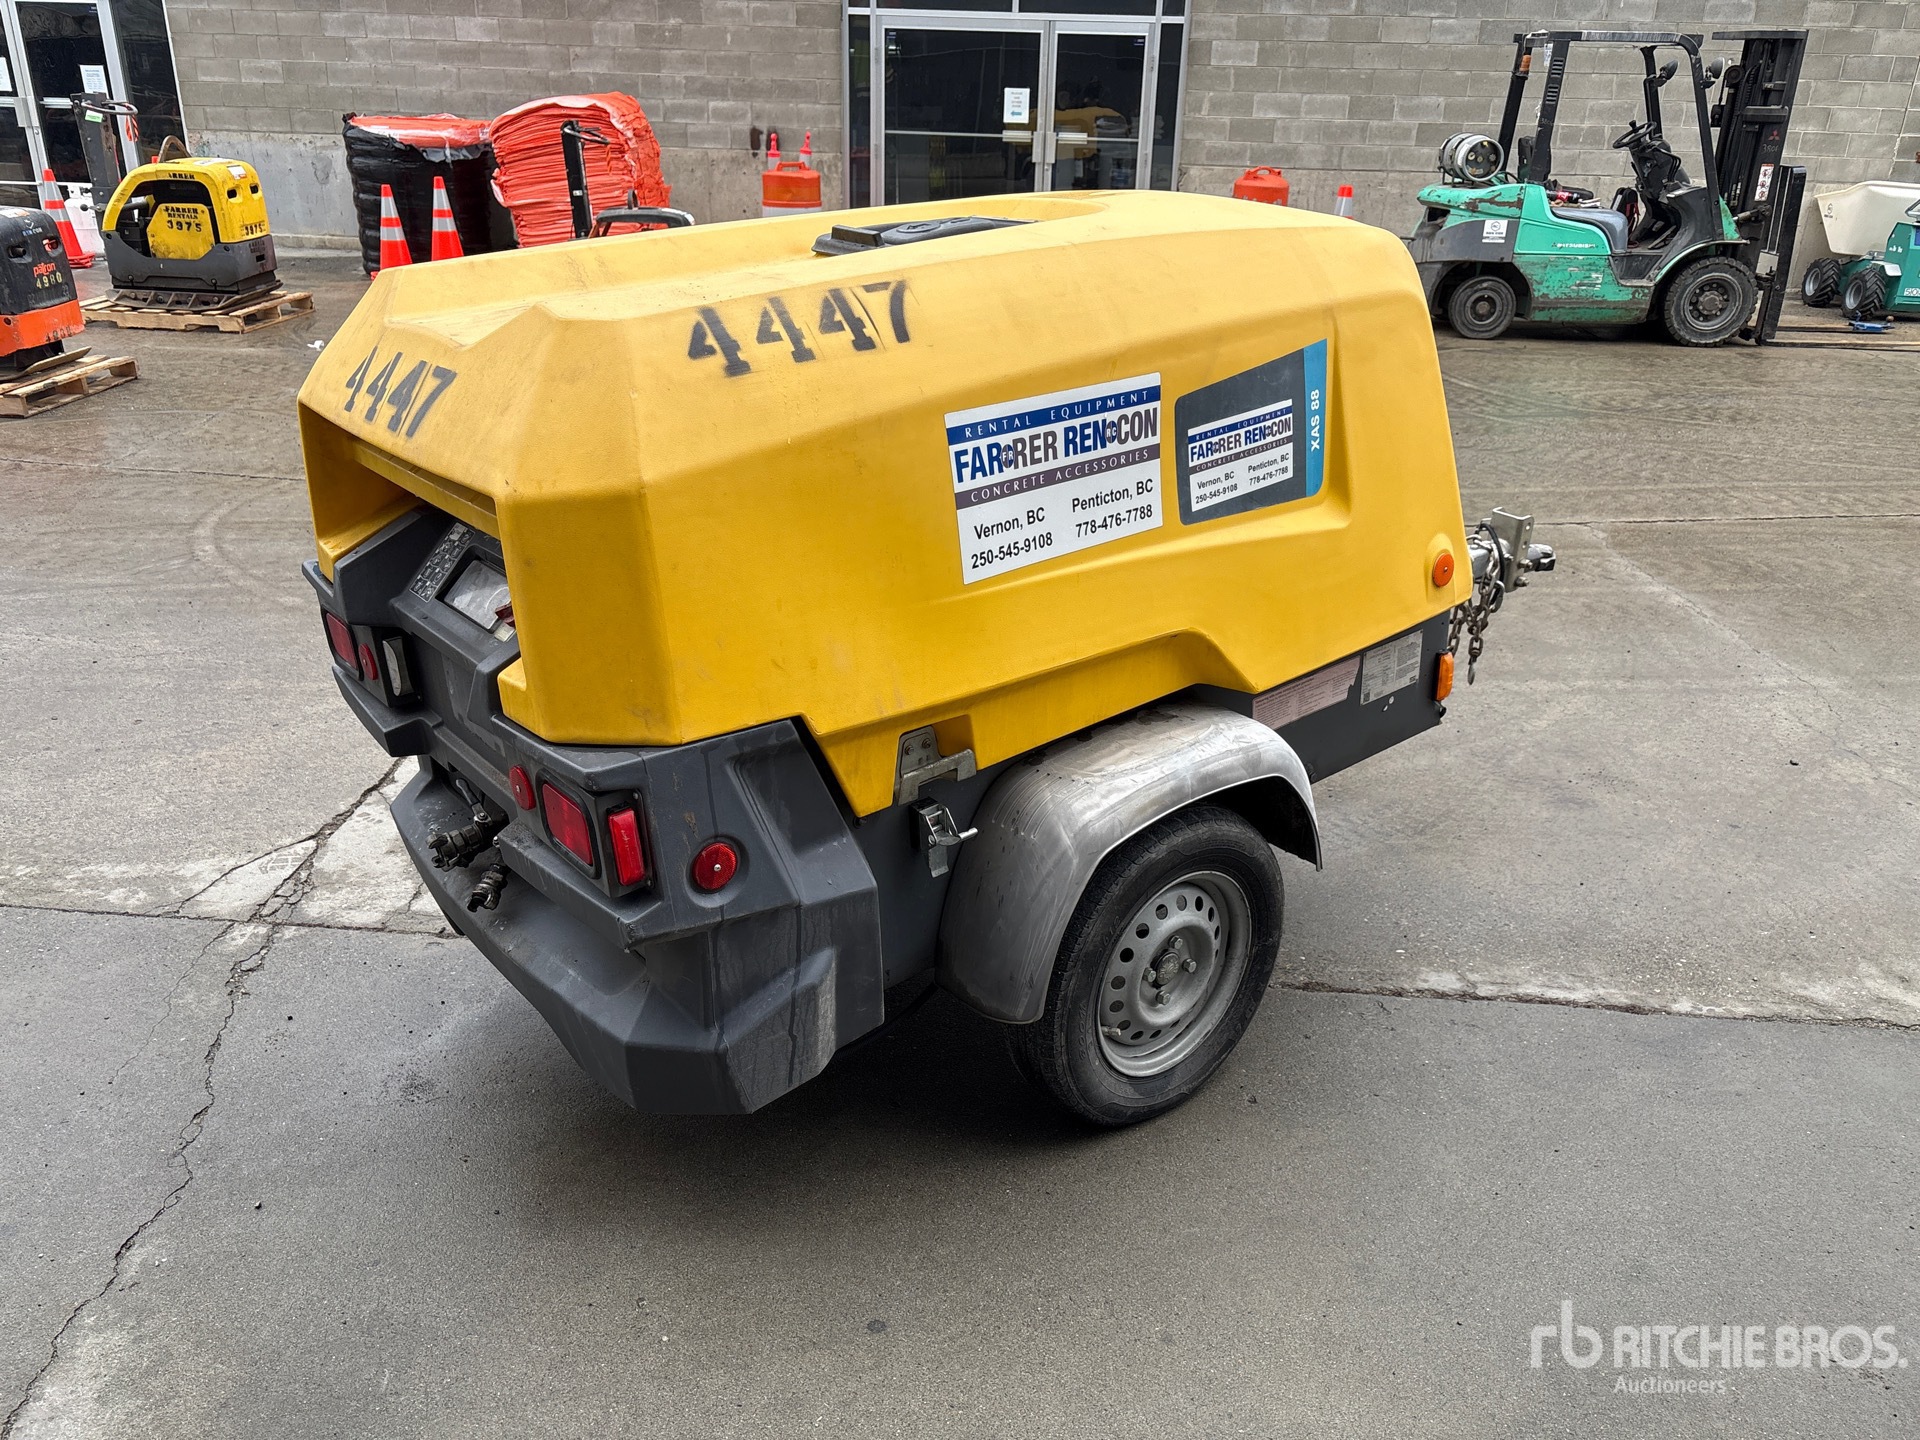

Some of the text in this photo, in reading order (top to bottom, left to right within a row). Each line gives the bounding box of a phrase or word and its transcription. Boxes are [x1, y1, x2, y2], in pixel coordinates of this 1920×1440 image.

[166, 220, 202, 233] 3975
[244, 223, 263, 236] 3975
[35, 271, 63, 289] 4980
[687, 279, 910, 377] 4447
[343, 345, 457, 439] 4447
[965, 390, 1149, 438] RENTAL EQUIPMENT
[1195, 409, 1287, 441] RENTAL EQUIPMENT
[1310, 389, 1320, 452] XAS 88
[1196, 438, 1288, 471] CONCRETE ACCESSORIES
[1247, 453, 1290, 474] Penticton, BC
[971, 449, 1149, 503] CONCRETE ACCESSORIES
[1197, 471, 1235, 490] Vernon, BC
[1249, 466, 1289, 486] 778-476-7788
[1071, 478, 1154, 513] Penticton, BC
[1195, 483, 1238, 504] 250-545-9108
[974, 507, 1045, 540] Vernon, BC
[1075, 504, 1153, 538] 778-476-7788
[971, 531, 1053, 569] 250-545-9108
